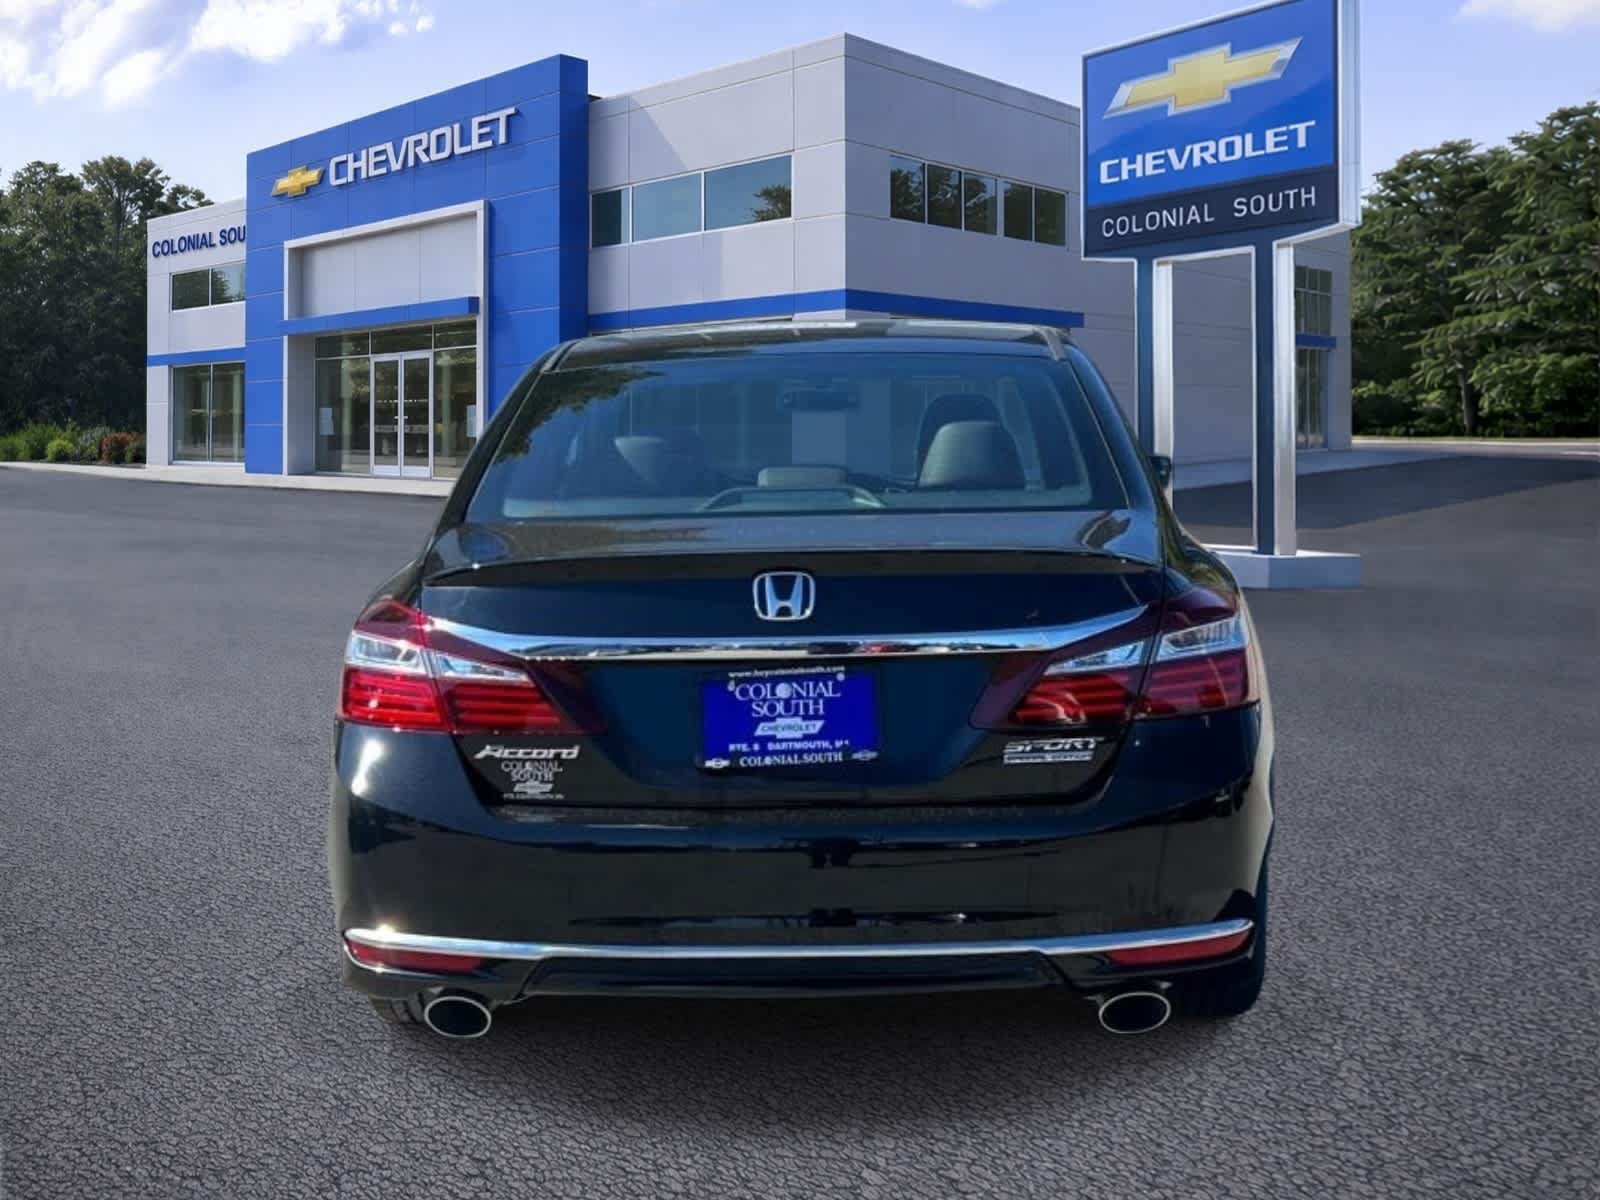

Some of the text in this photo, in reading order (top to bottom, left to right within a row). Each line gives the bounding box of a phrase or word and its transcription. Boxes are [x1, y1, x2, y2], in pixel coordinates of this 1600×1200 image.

[327, 105, 519, 188] CHEVROLET
[1100, 120, 1316, 185] CHEVROLET
[1102, 186, 1317, 238] COLONIAL SOUTH
[152, 231, 216, 258] COLONIAL
[735, 681, 841, 700] COLONIAL
[752, 699, 824, 717] SOUTH
[474, 744, 580, 759] Accord
[1003, 737, 1104, 753] SPORT
[739, 751, 843, 768] COLONIAL SOUTH
